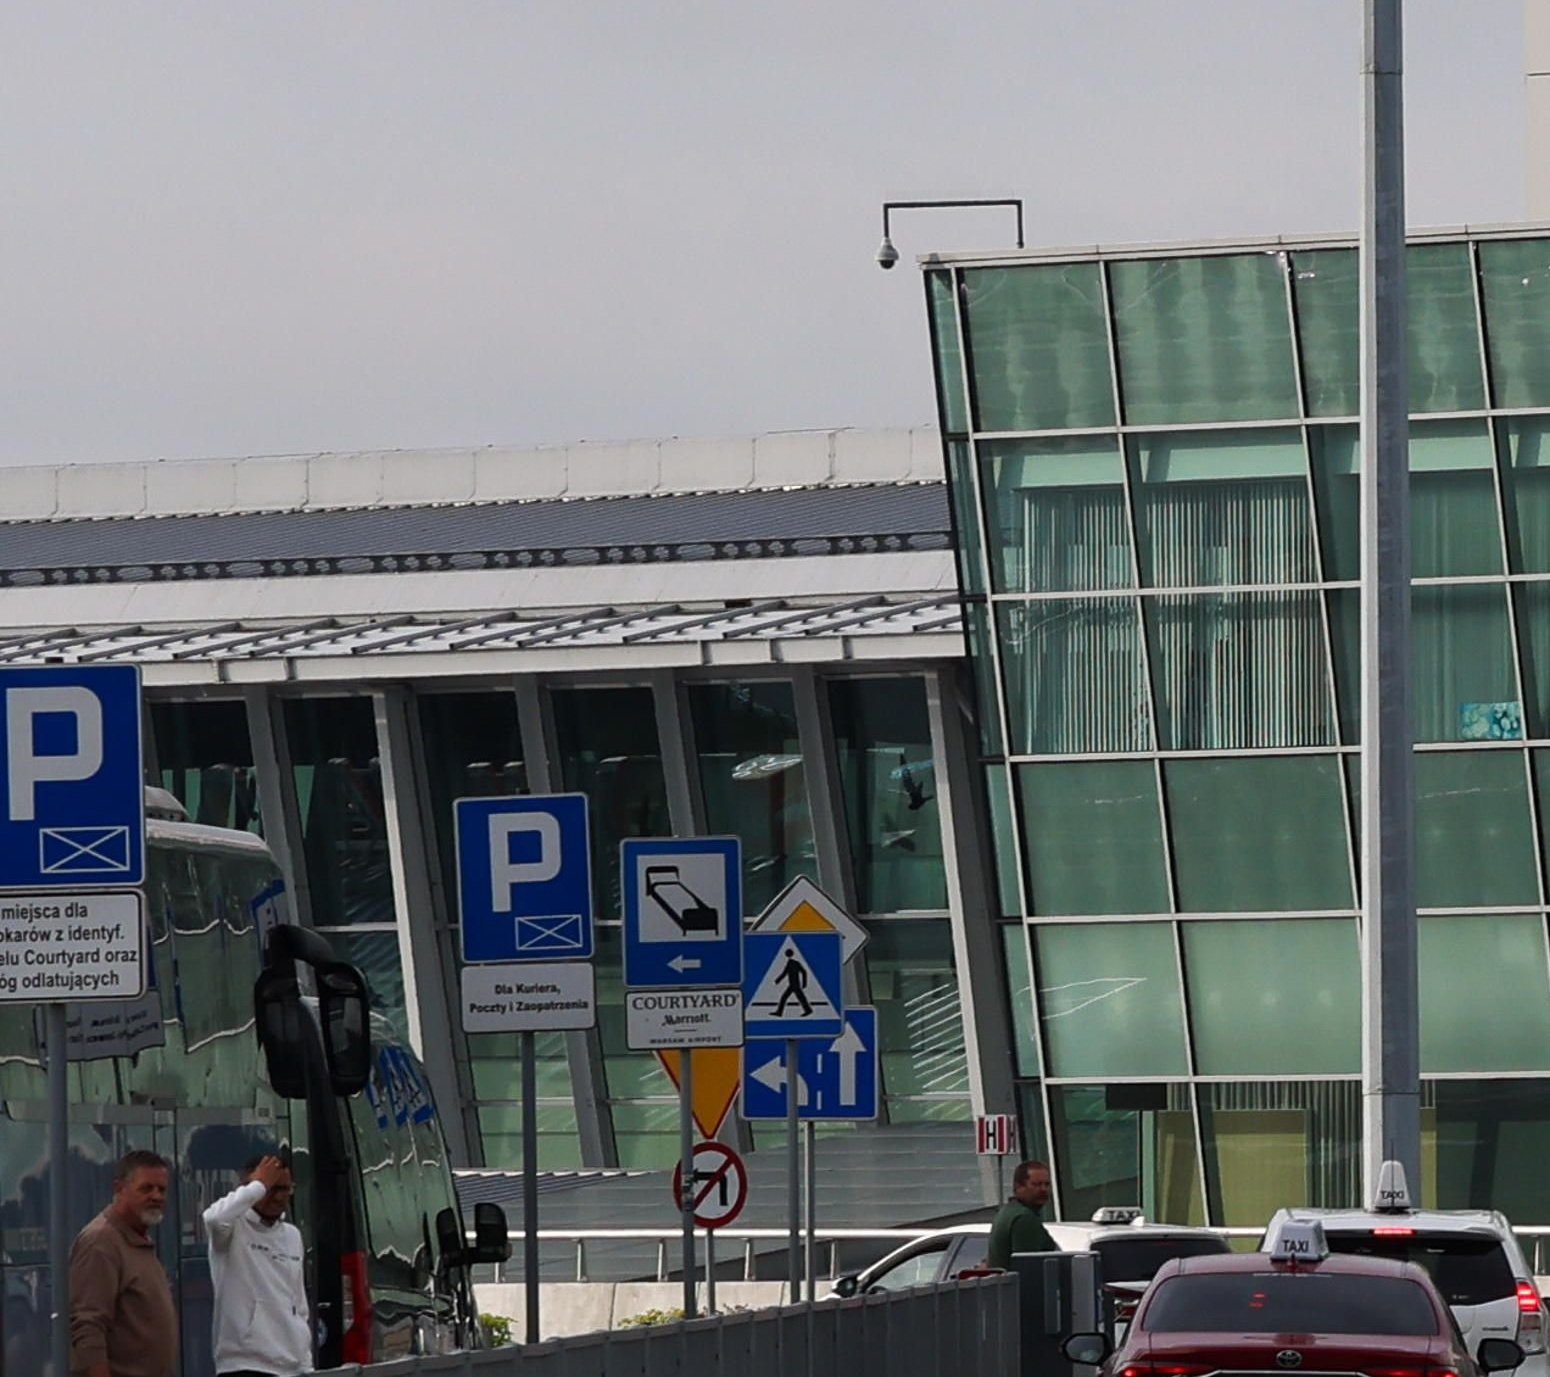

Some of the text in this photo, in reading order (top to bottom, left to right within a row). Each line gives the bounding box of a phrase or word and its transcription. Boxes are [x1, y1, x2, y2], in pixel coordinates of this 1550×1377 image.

[6, 686, 103, 821] P
[488, 811, 562, 913] P
[1, 902, 88, 923] miejsca dla
[55, 929, 64, 941] z
[68, 923, 125, 944] identyf.
[24, 947, 100, 968] Courtyard
[104, 950, 137, 964] oraz
[22, 970, 120, 991] odlatujących
[495, 984, 513, 995] Dla
[469, 1003, 506, 1015] Poczty
[632, 994, 737, 1010] COURTYARD
[986, 1120, 997, 1149] H
[1380, 1189, 1405, 1200] TAXI
[1108, 1210, 1140, 1222] TAXI
[1282, 1239, 1310, 1253] TAXI
